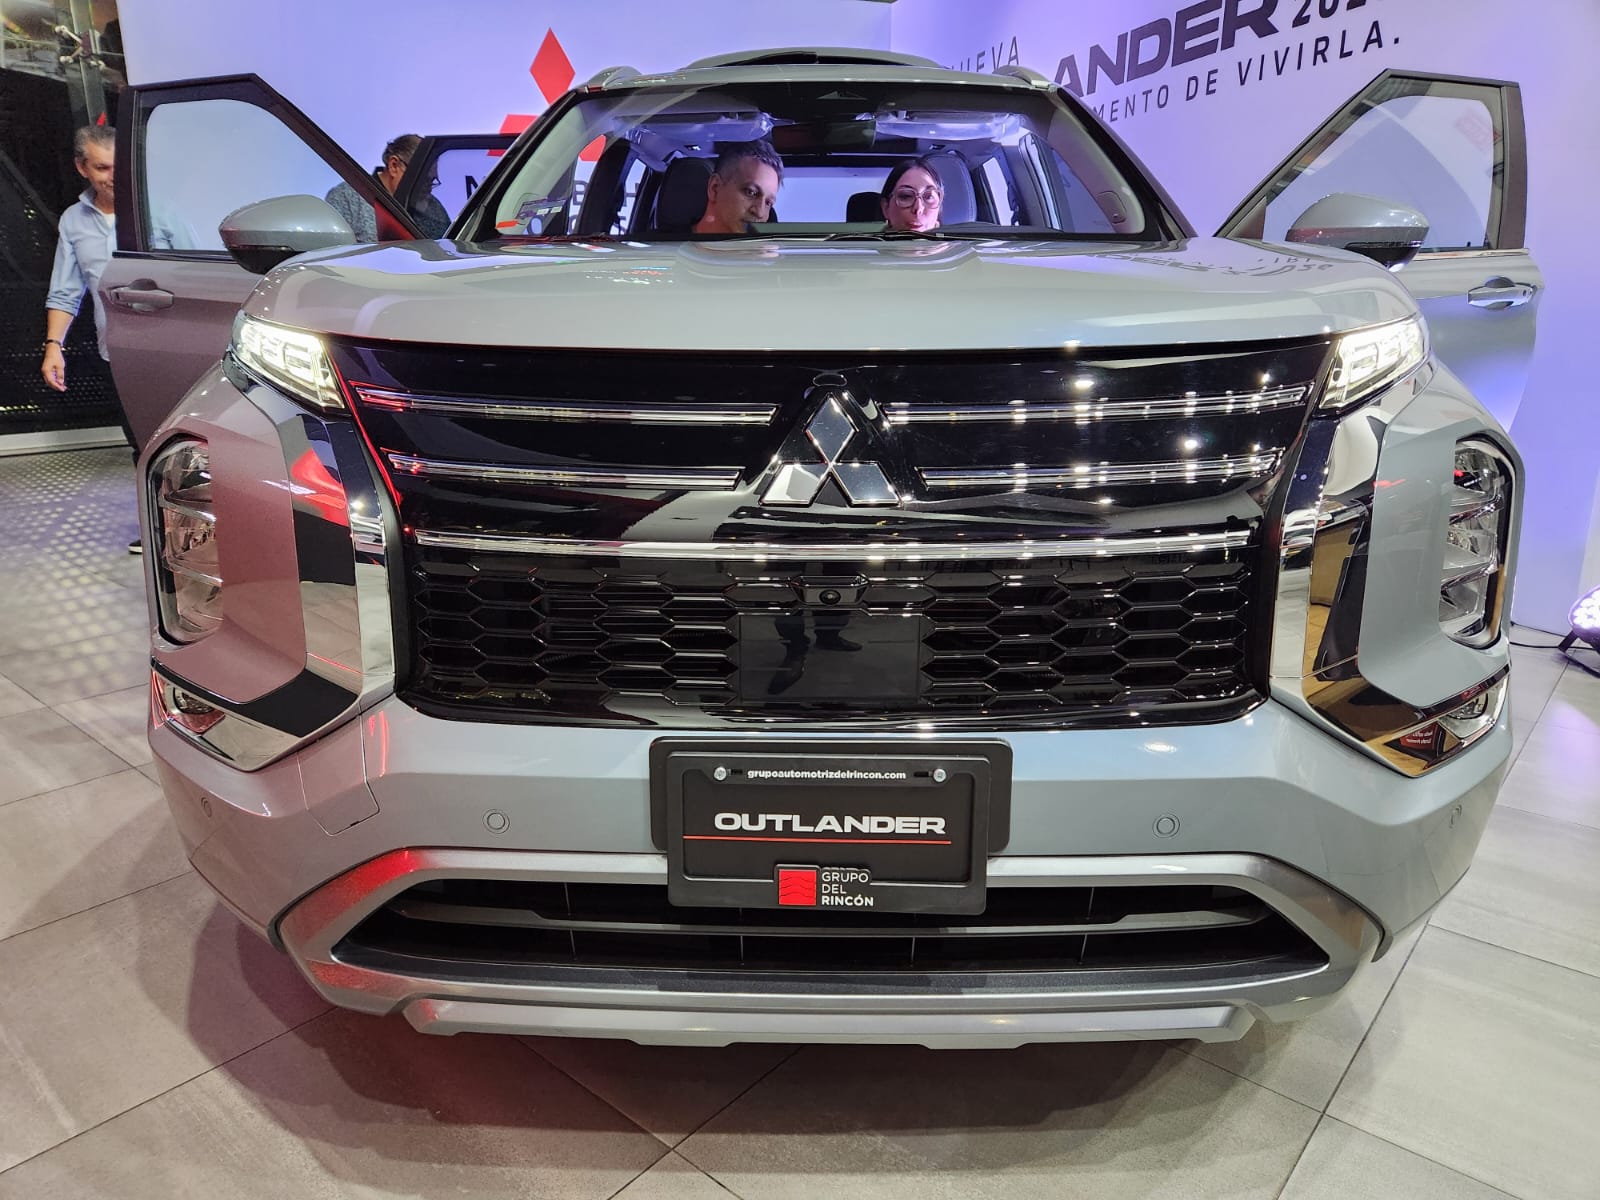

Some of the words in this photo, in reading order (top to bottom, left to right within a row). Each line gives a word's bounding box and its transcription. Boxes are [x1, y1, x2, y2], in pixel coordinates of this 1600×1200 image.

[1185, 69, 1219, 101] DE
[1238, 20, 1400, 86] VIVIRLA.
[747, 769, 906, 781] grupoautomotrizdelrincon.com
[714, 812, 946, 834] OUTLANDER
[821, 871, 869, 883] GRUPO
[821, 883, 847, 894] DEL
[821, 893, 874, 907] RINCÓN
